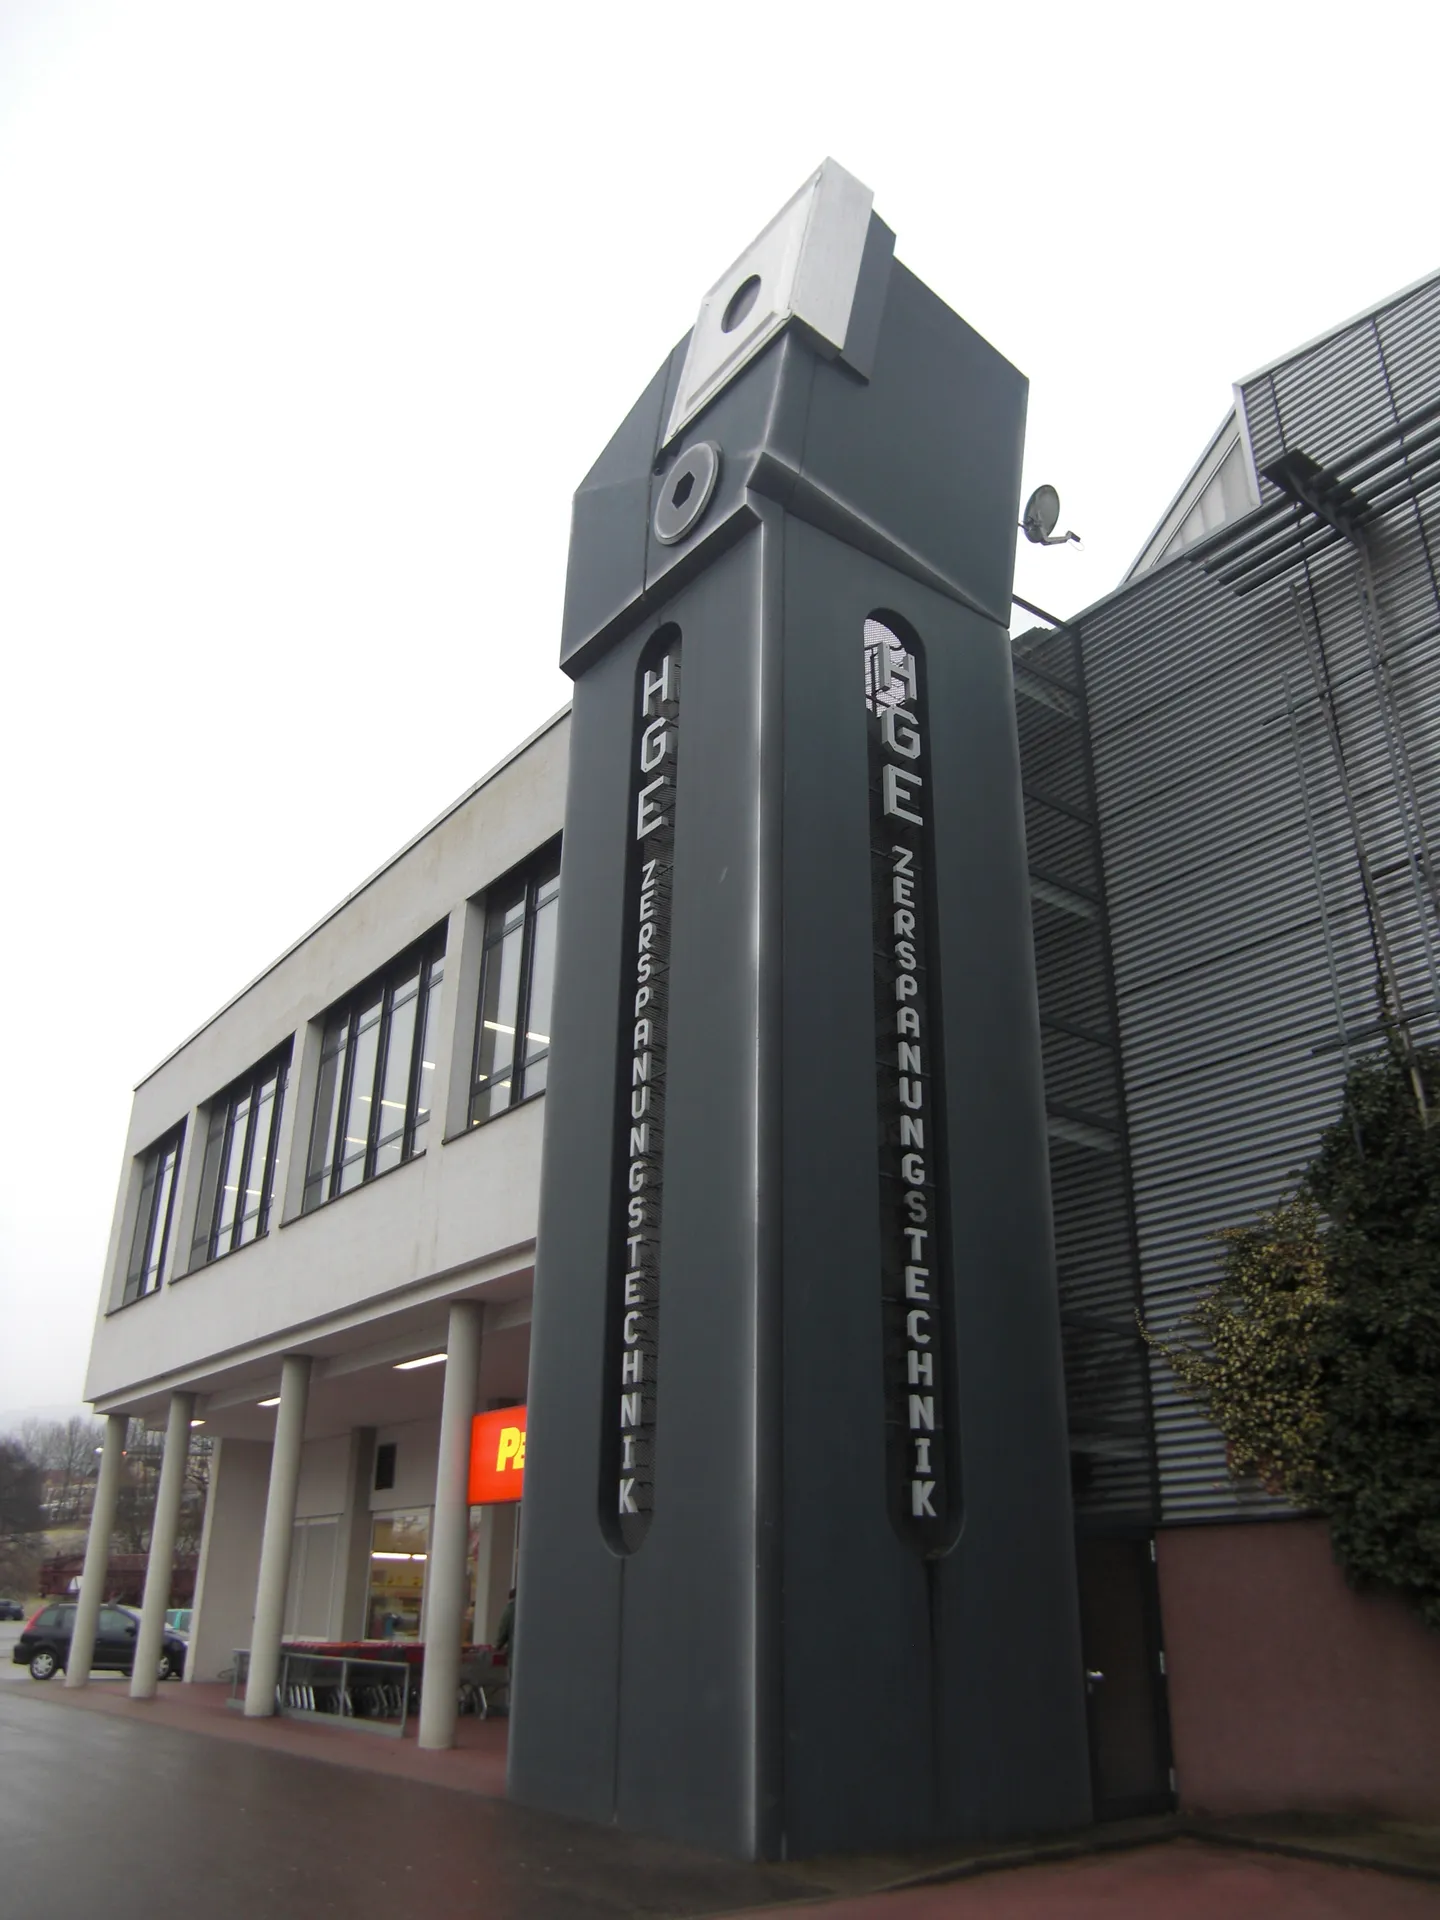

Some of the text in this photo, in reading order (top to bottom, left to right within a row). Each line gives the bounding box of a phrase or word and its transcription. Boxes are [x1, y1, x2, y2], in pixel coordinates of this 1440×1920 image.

[618, 654, 671, 1514] HGE ZERSPANUNGSTECHNIK
[877, 641, 937, 1517] HGE ZERSPANUNGSTECHNIK
